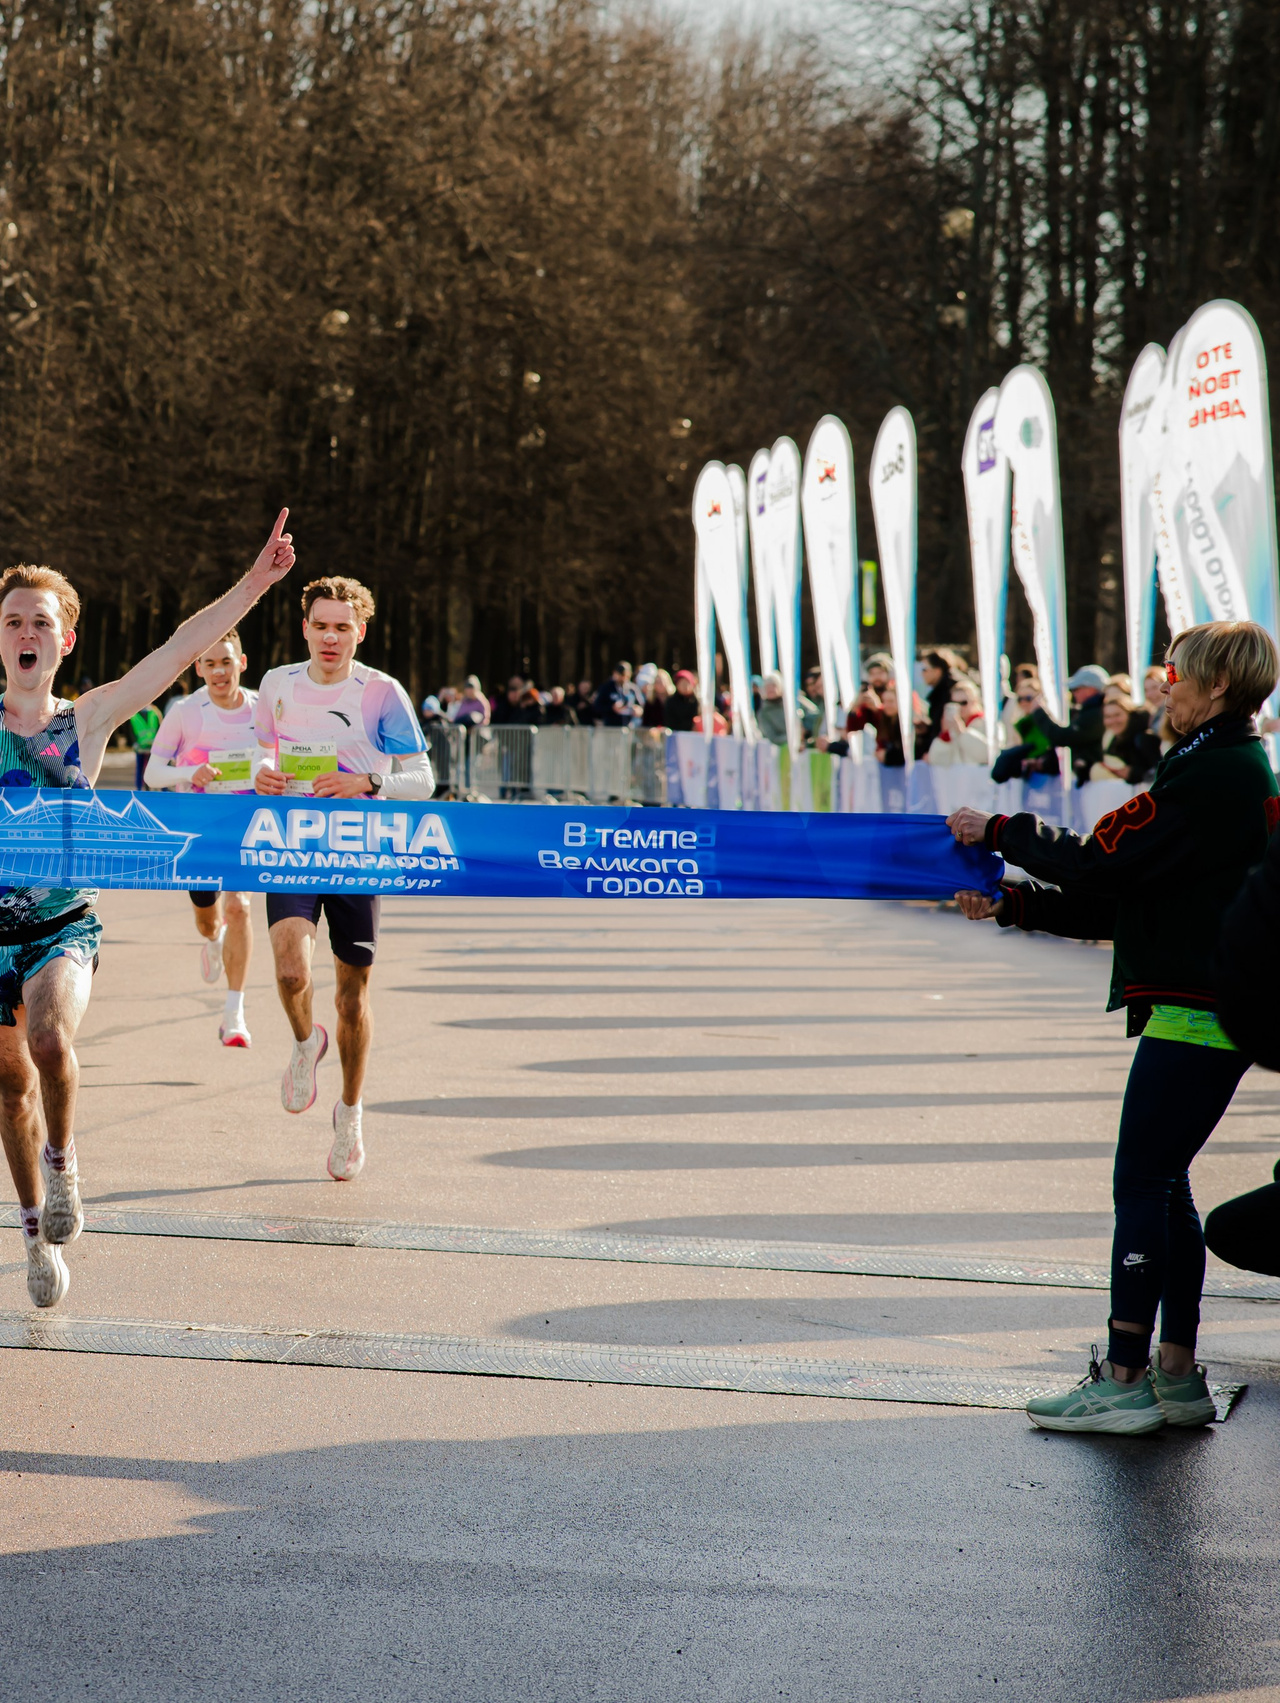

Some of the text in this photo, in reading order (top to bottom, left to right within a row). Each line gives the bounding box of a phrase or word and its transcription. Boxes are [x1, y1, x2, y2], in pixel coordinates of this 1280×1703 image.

[240, 808, 455, 855] АРЕНА
[563, 822, 698, 849] В темпе
[240, 849, 460, 870] ПОЛУМАРАФОН
[538, 850, 699, 875] Великого
[258, 871, 441, 889] Санкт-Петербург
[586, 876, 704, 896] города
[1127, 1252, 1145, 1261] NIKE
